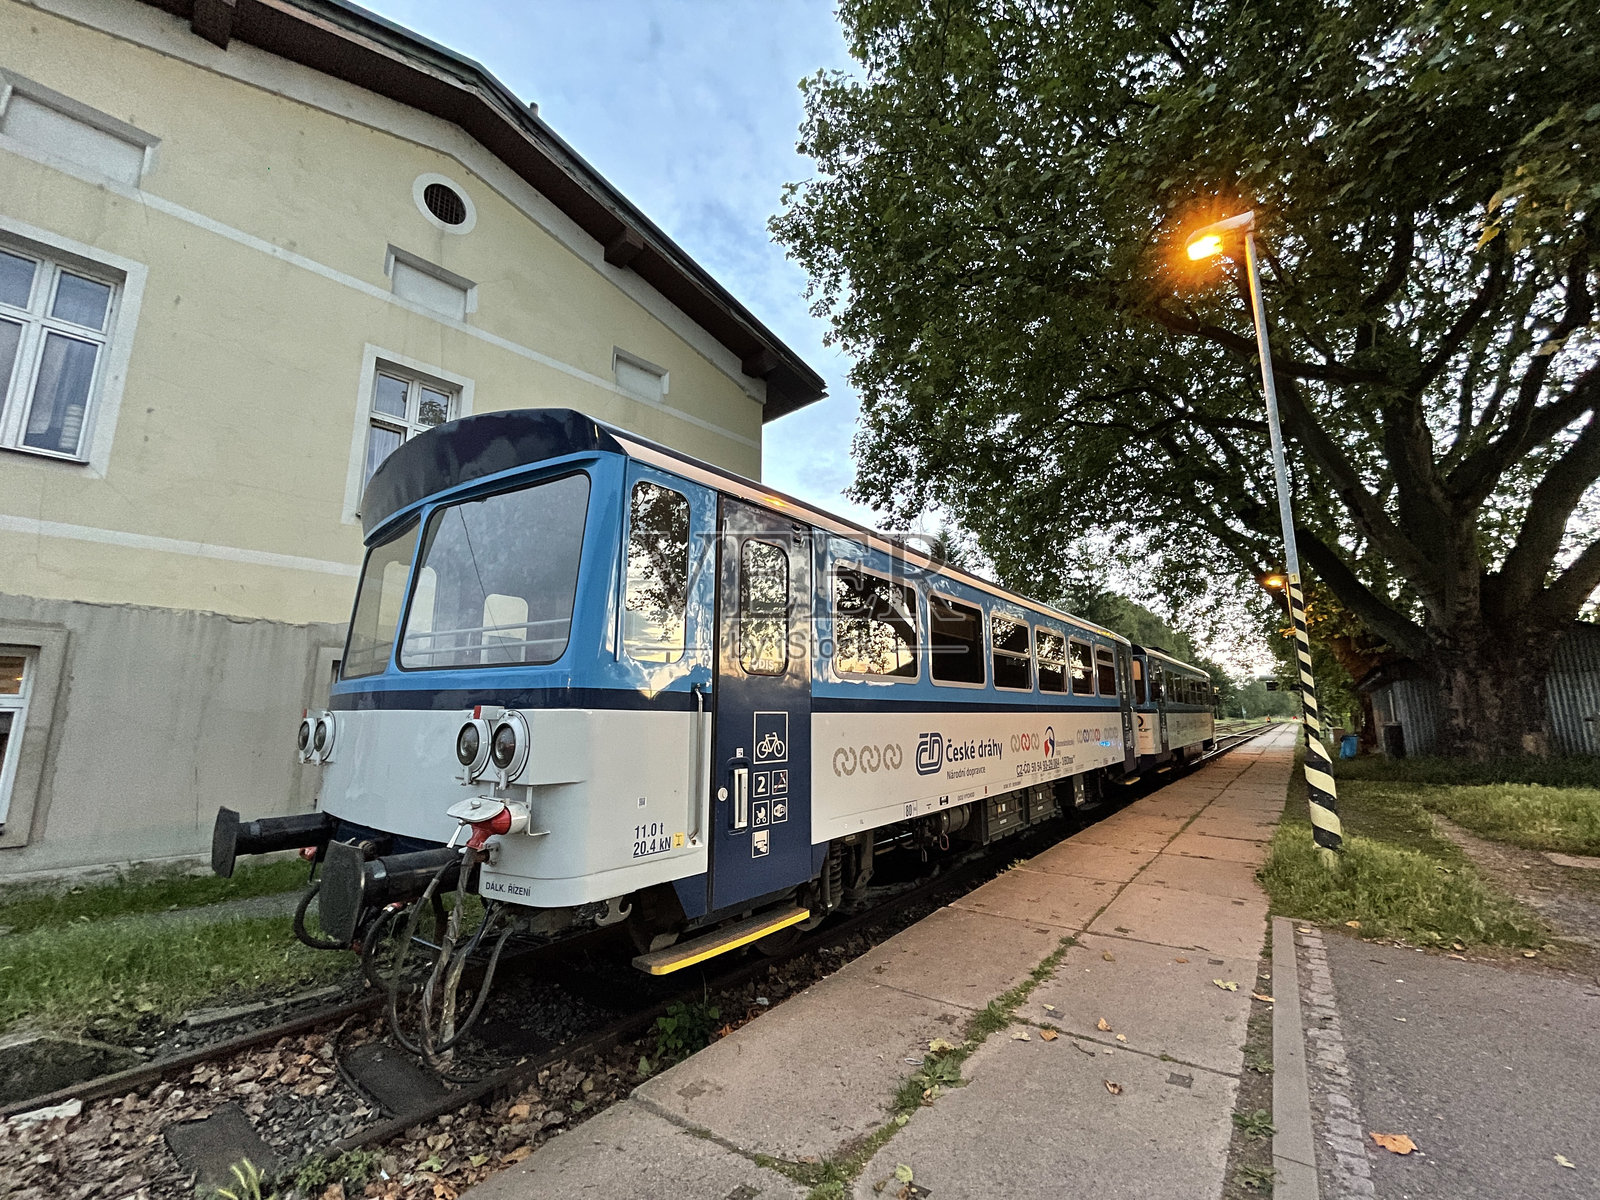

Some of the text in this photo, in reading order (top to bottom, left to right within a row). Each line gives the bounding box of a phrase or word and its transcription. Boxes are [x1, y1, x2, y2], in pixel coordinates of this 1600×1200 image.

[946, 738, 1003, 763] České dráhy
[946, 766, 986, 780] Národní dopravce
[757, 776, 766, 793] 2
[905, 804, 913, 817] 80
[634, 822, 664, 840] 11.0 t
[633, 836, 672, 856] 20.4 kN
[485, 881, 531, 897] DÁLK. ŘÍZENÍ
